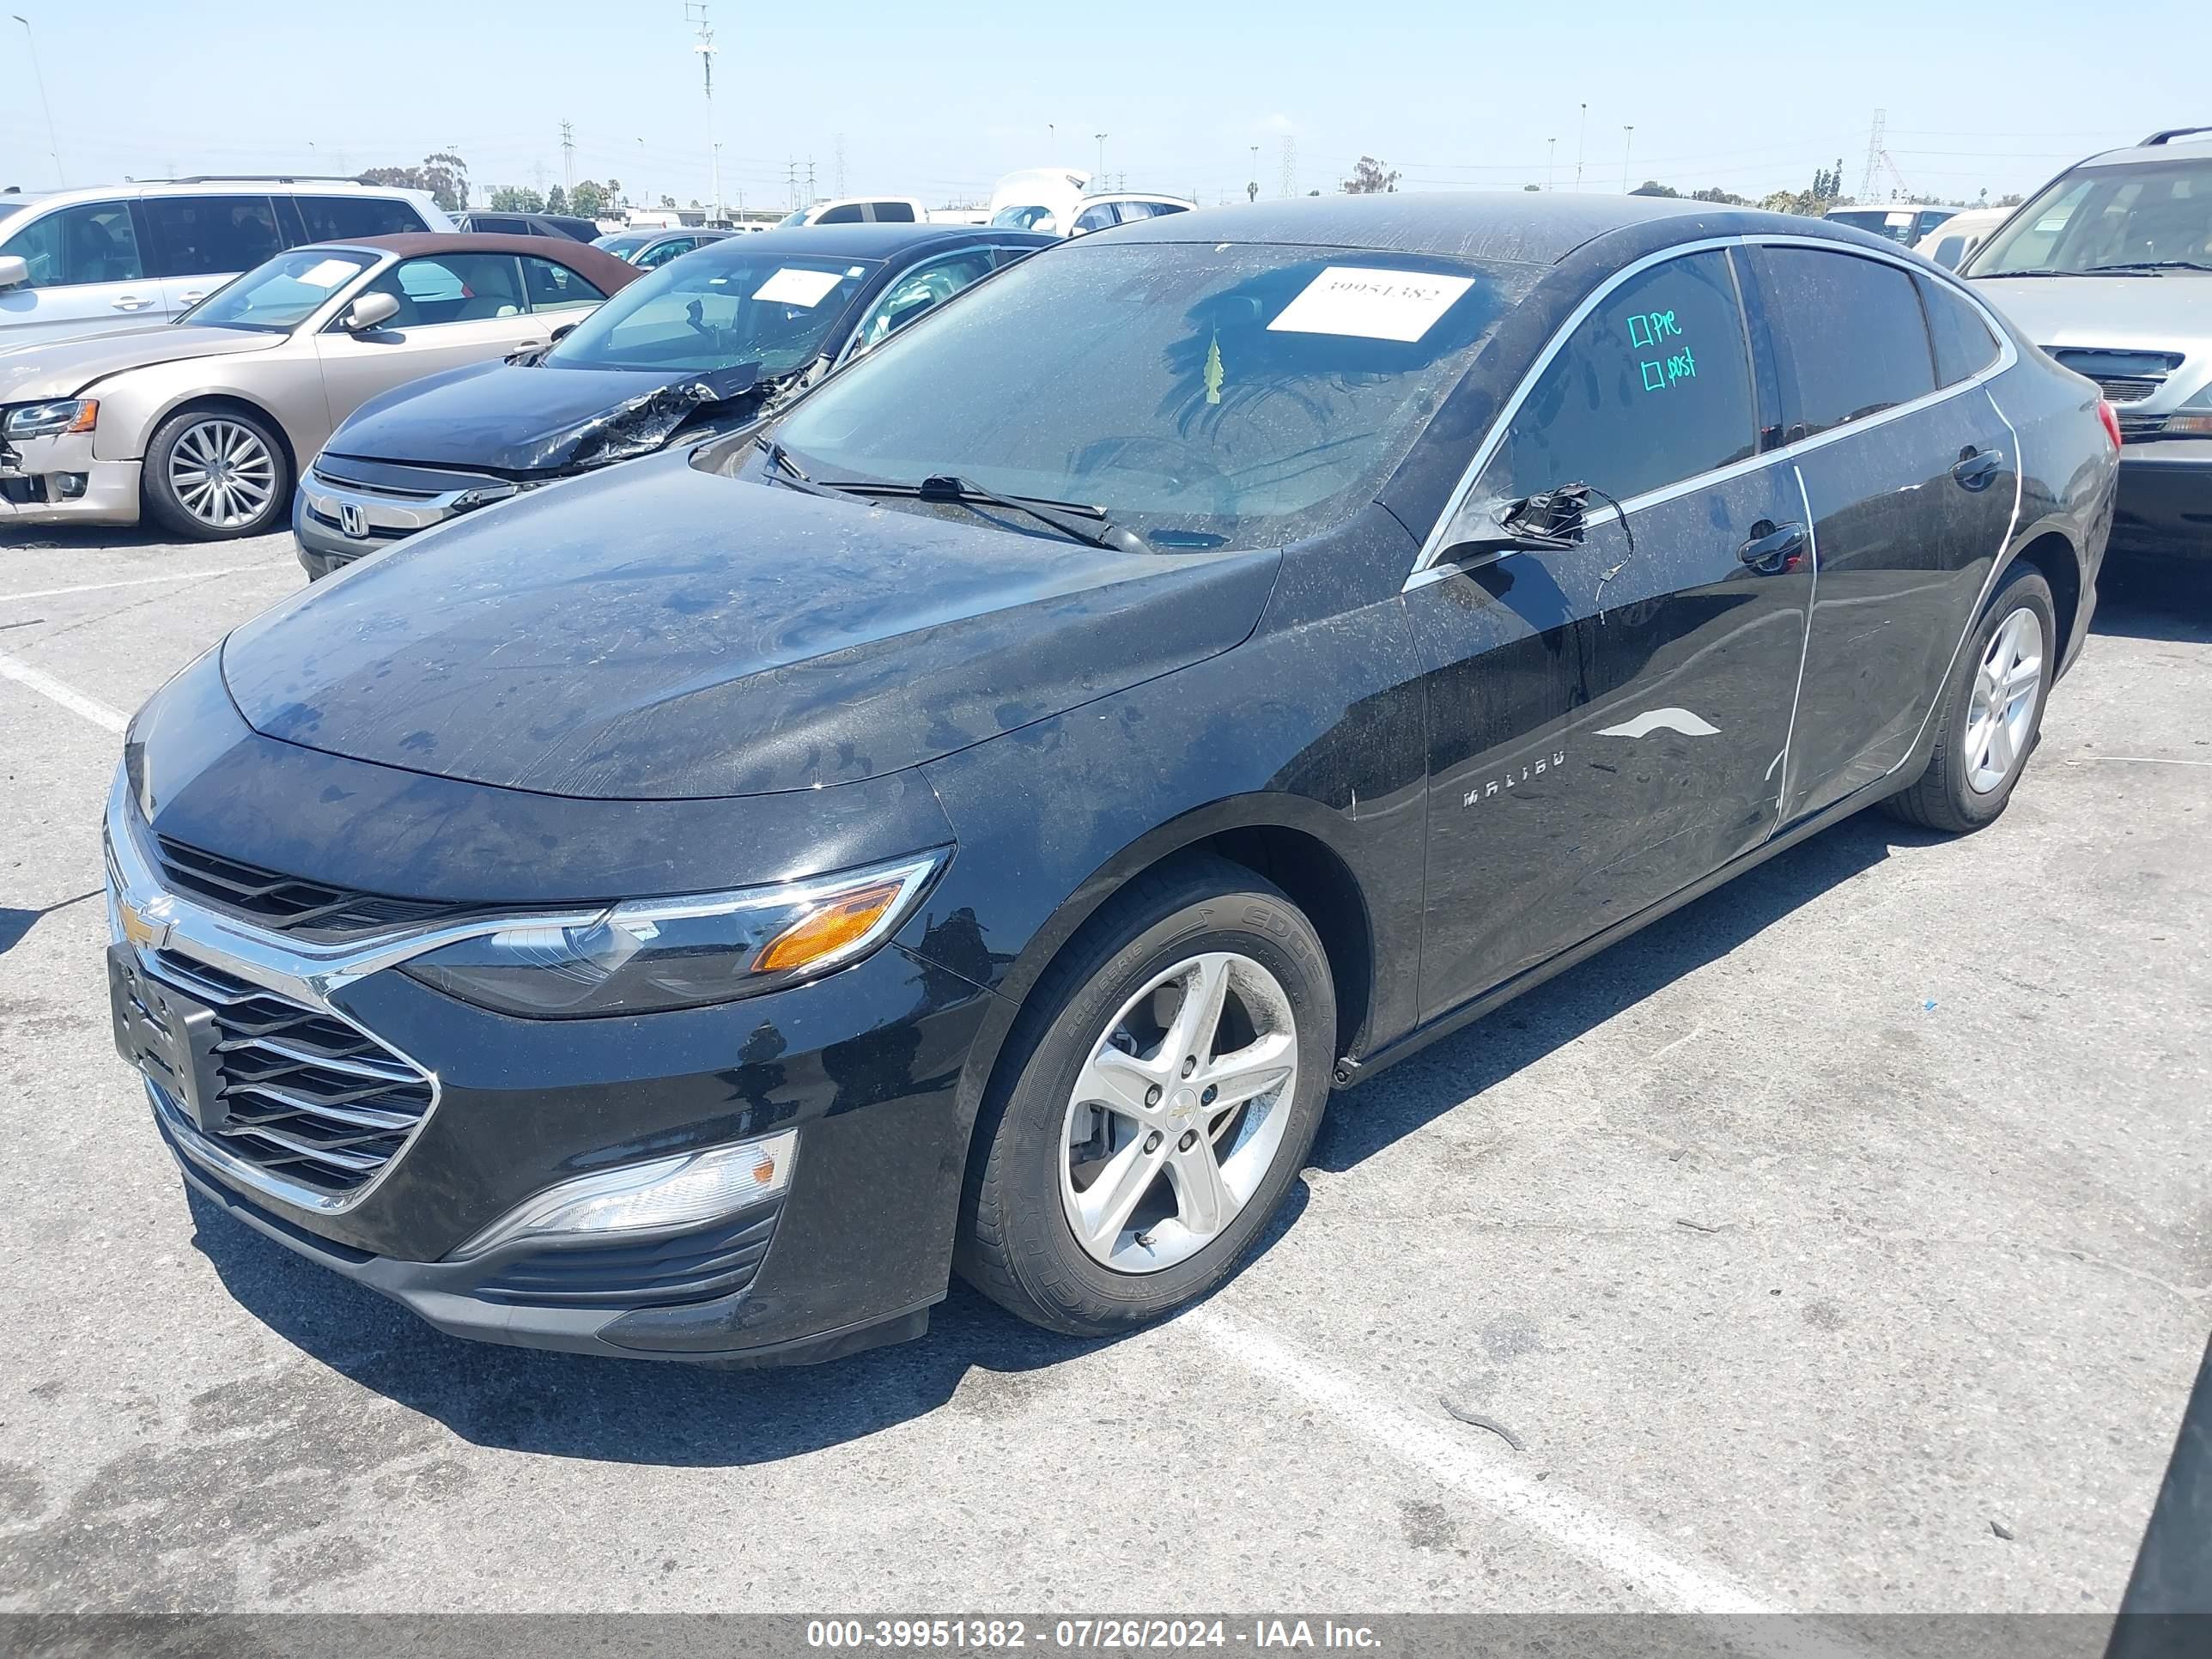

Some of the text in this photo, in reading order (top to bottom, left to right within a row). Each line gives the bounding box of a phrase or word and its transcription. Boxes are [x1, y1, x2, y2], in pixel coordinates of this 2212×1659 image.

[1667, 346, 1696, 387] post
[1462, 750, 1565, 808] MALIBU
[1242, 904, 1323, 983] EDGE
[1016, 1194, 1114, 1322] KELLY
